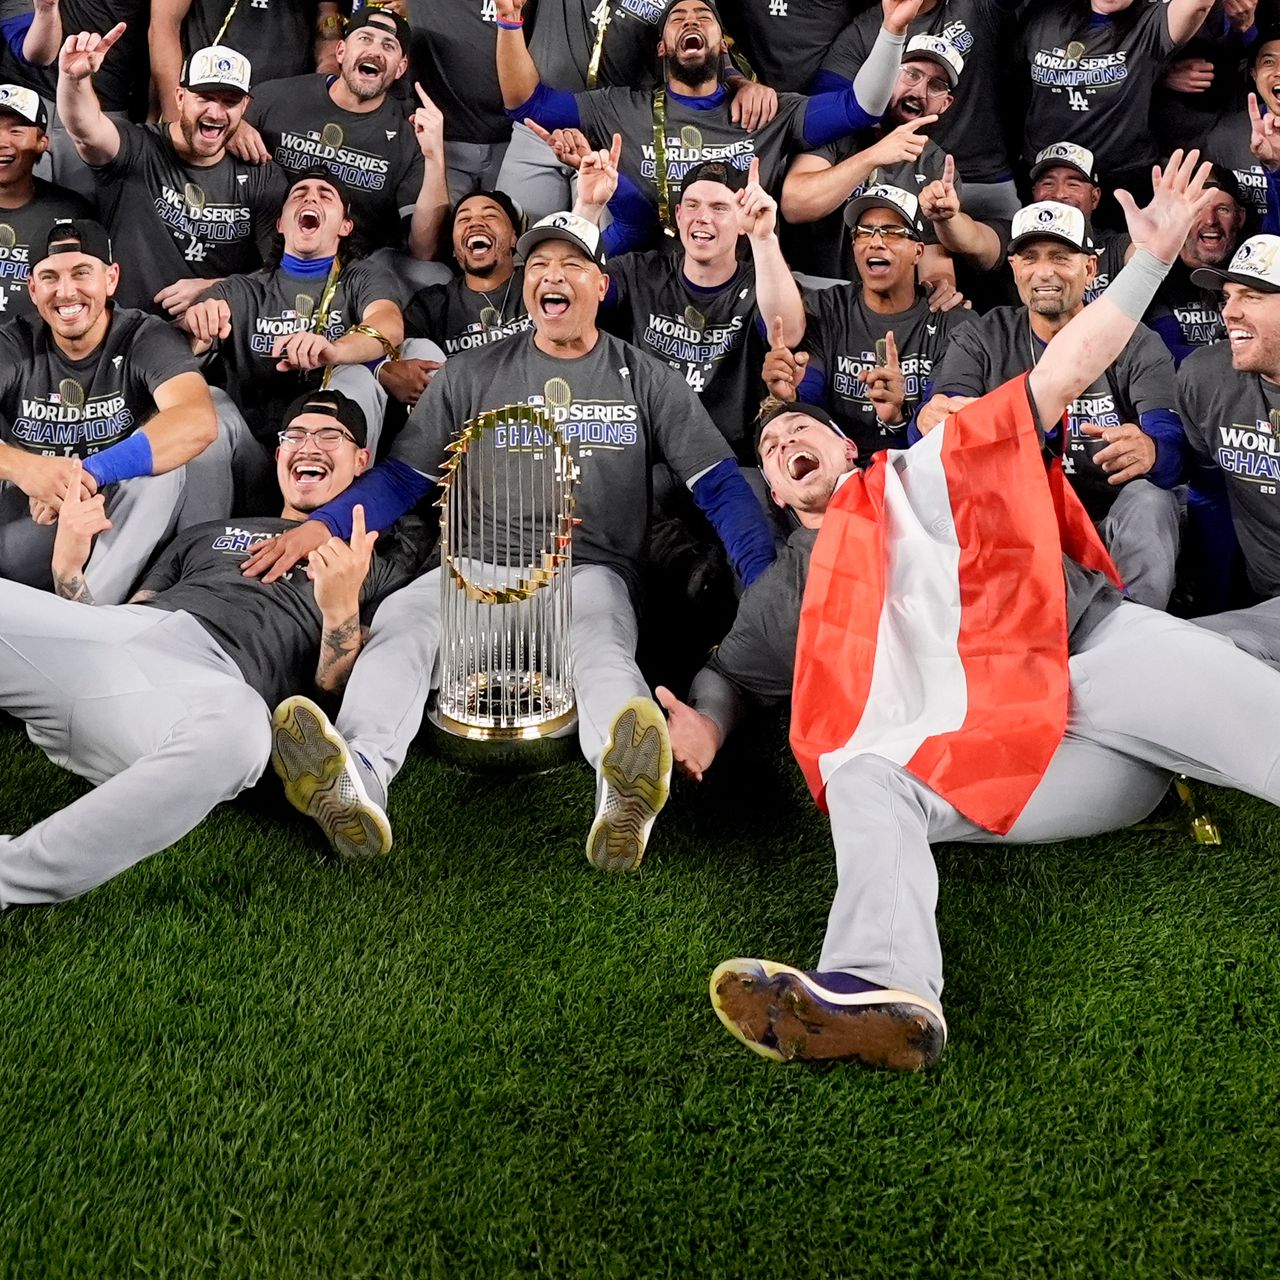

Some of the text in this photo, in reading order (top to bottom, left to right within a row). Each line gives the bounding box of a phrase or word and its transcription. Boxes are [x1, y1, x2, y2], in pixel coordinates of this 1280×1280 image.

[281, 132, 391, 174] WORLD SERIES
[11, 407, 135, 445] CHAMPIONS
[569, 404, 638, 423] SERIES
[1259, 484, 1276, 495] 20
